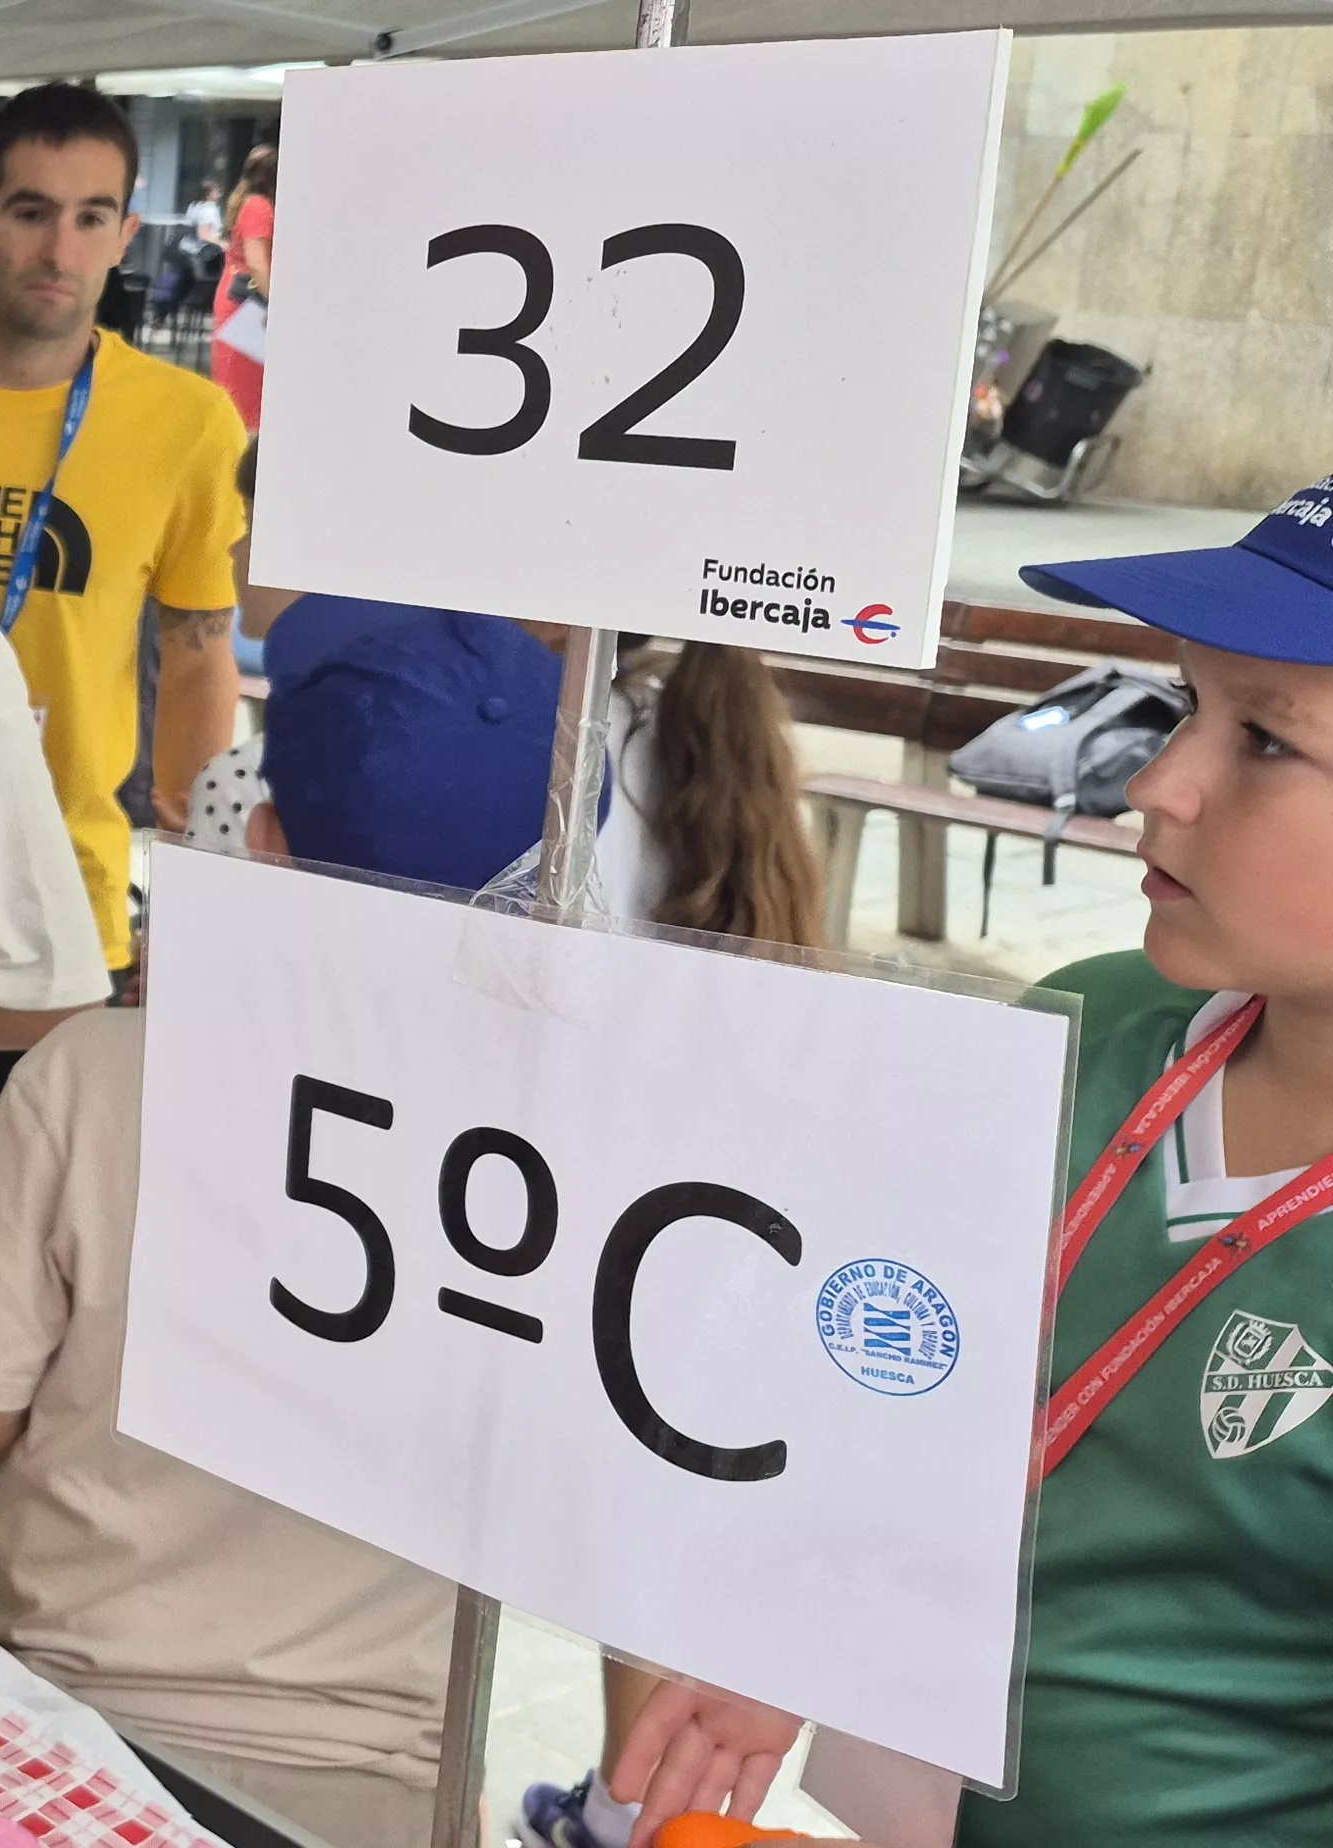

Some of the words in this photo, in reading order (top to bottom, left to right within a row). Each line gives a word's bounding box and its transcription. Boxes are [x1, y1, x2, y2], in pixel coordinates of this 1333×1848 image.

[408, 222, 745, 472] 32
[702, 558, 836, 593] Fundación
[699, 589, 831, 633] Ibercaja
[268, 1073, 803, 1482] 5ºC
[820, 1264, 877, 1338] GOBIERNO
[883, 1264, 908, 1284] DE
[860, 1366, 915, 1385] HUESCA
[1211, 1376, 1244, 1391] S.D.
[1247, 1371, 1324, 1390] HUESCA
